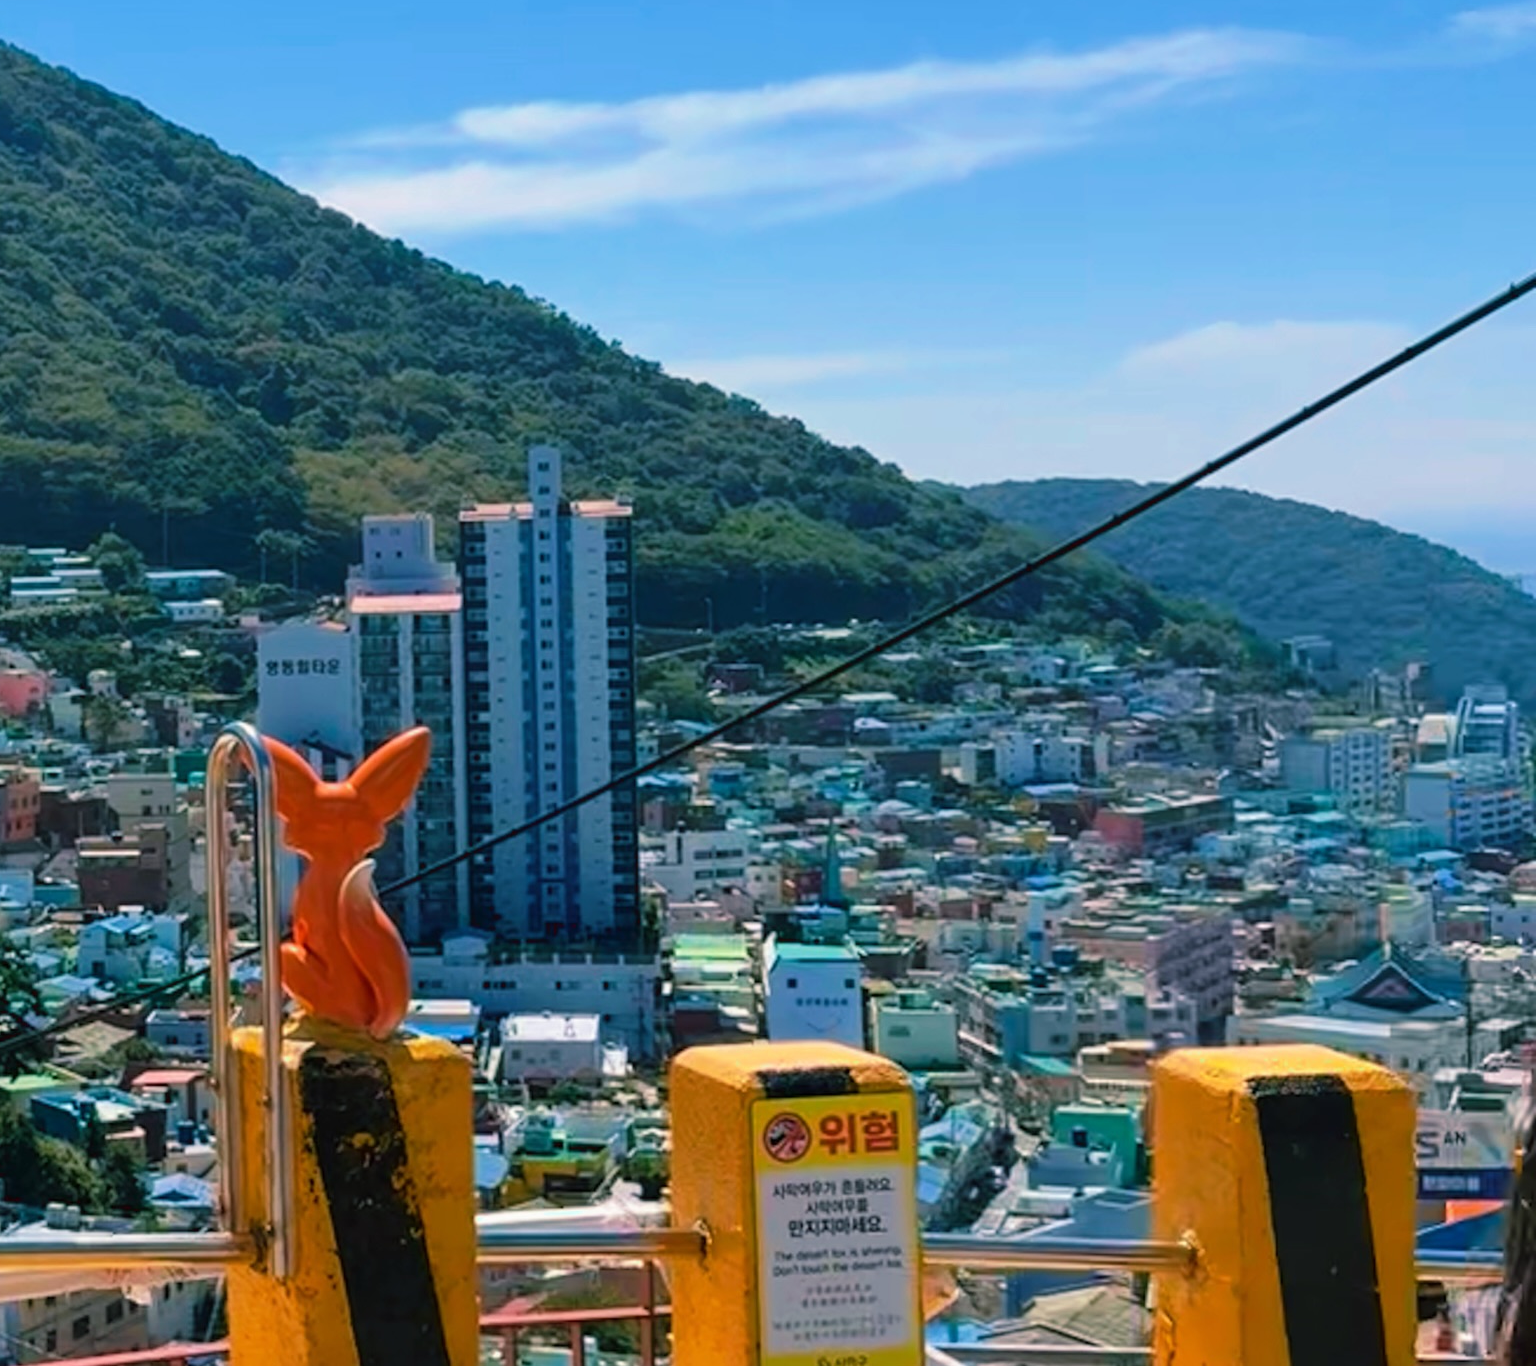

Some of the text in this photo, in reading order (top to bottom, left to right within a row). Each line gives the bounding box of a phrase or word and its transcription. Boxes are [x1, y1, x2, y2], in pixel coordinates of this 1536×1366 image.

[819, 1111, 899, 1155] 위험
[772, 1181, 837, 1199] 사막여우가
[805, 1197, 869, 1216] 사막여우를
[787, 1215, 888, 1238] 만지지마세요.
